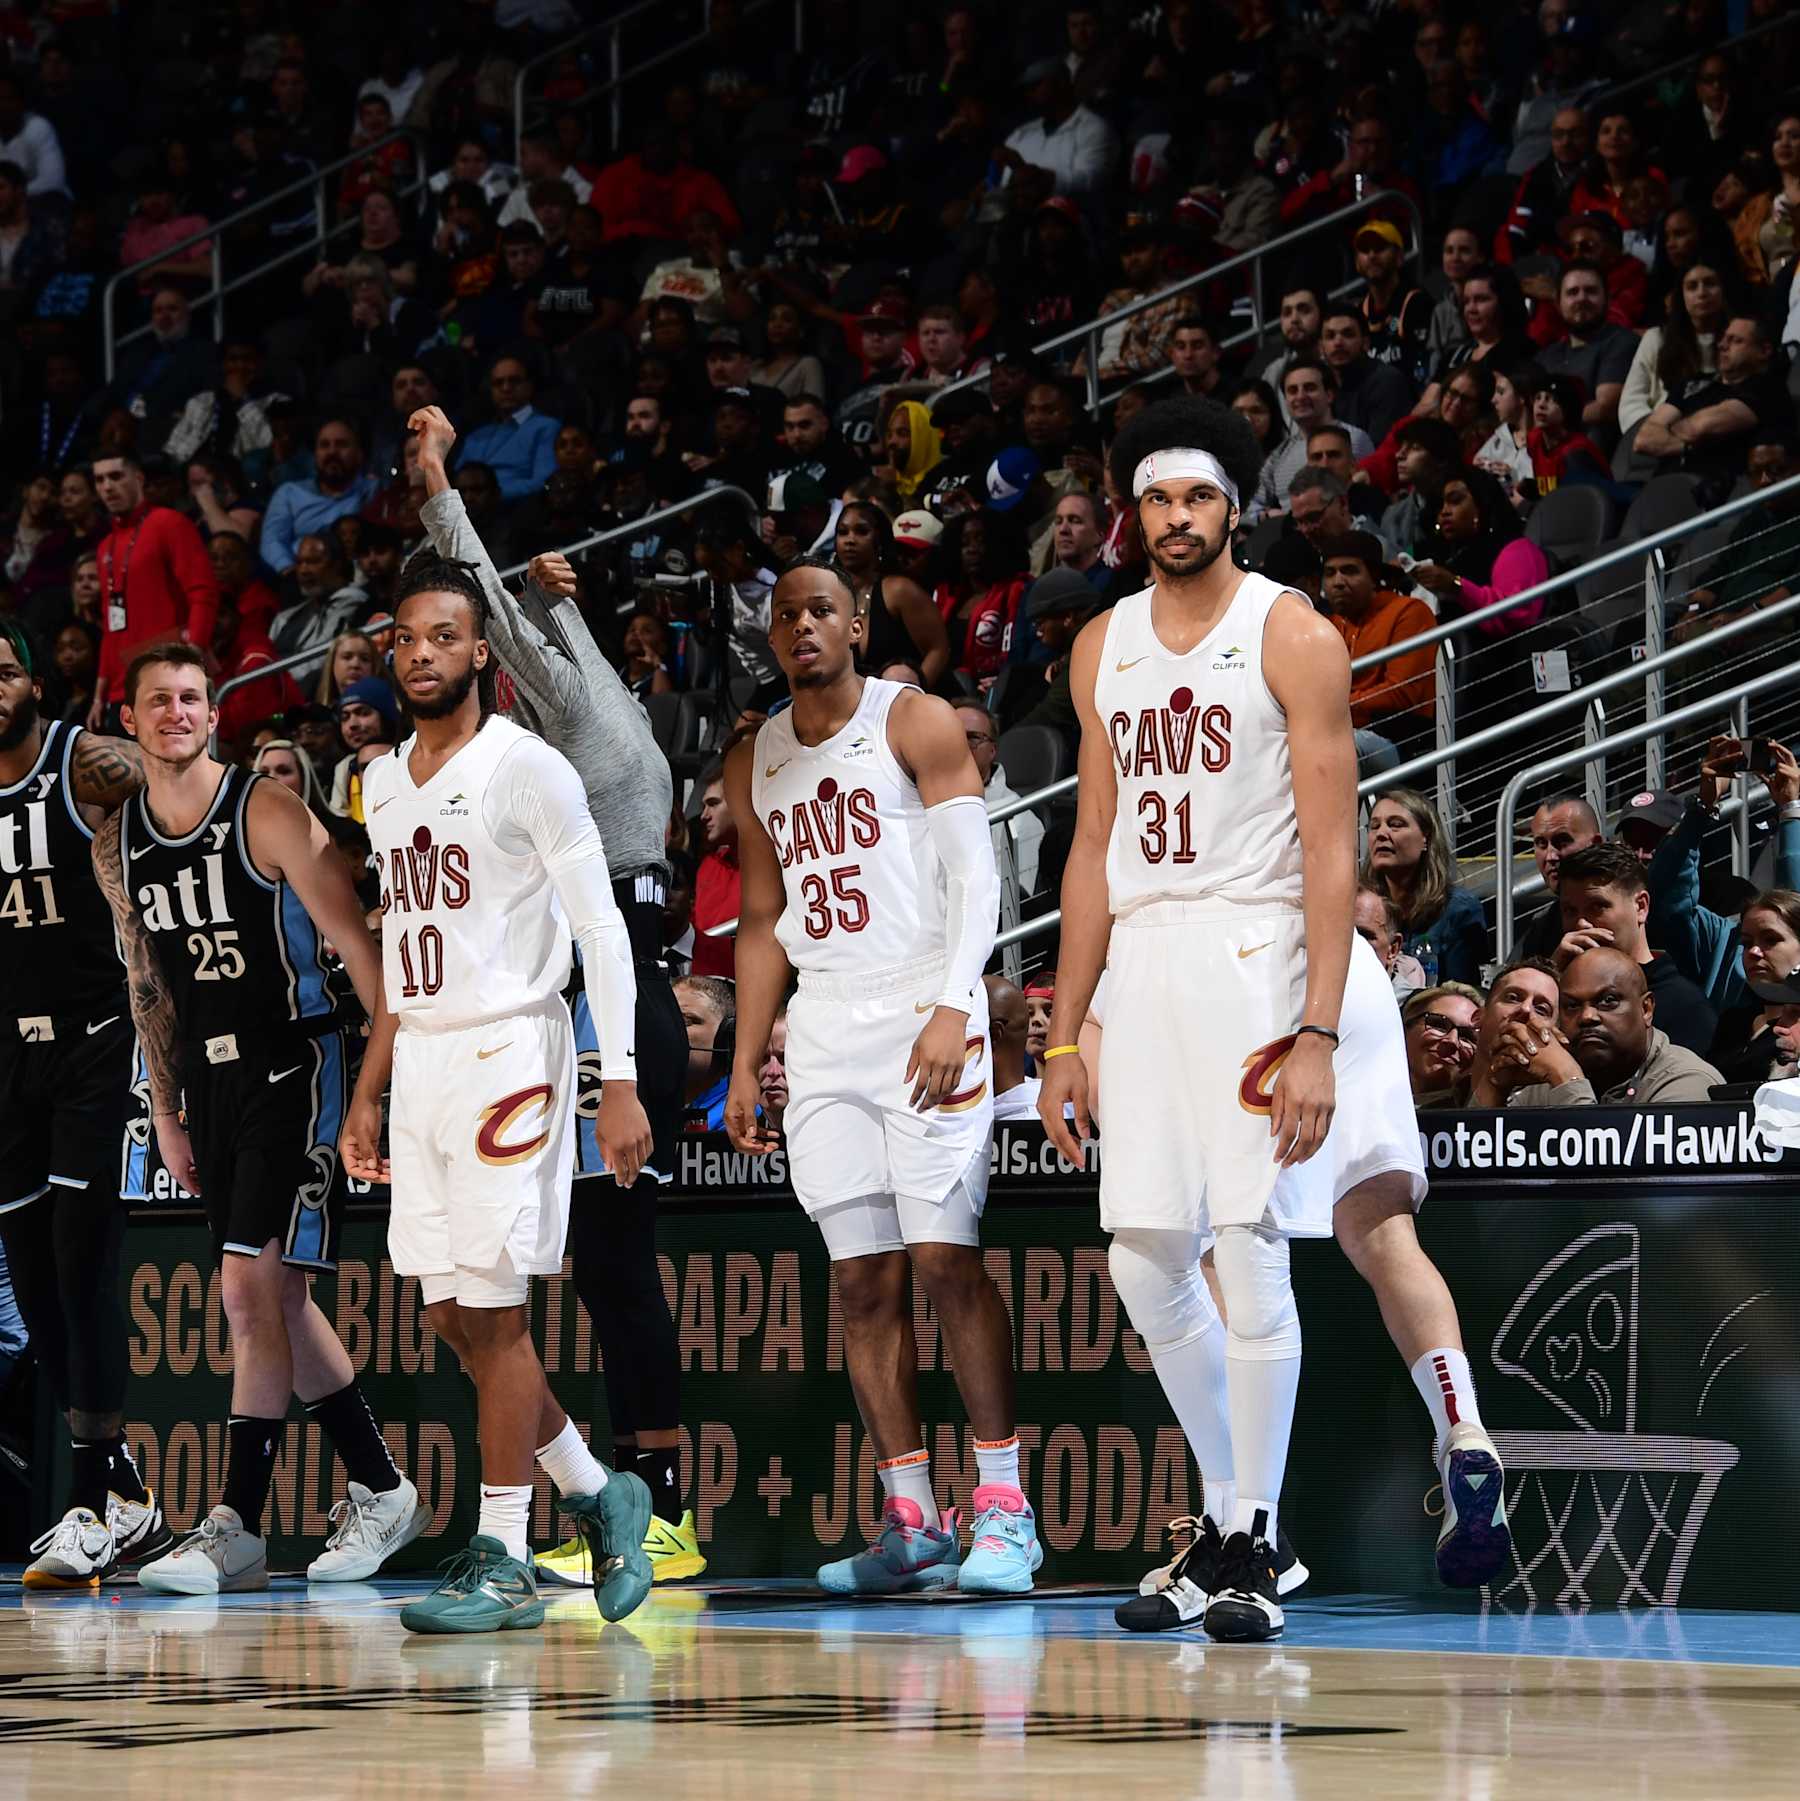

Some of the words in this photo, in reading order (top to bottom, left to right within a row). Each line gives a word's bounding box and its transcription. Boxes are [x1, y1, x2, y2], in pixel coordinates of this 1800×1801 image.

[1212, 662, 1245, 670] CLIFFS
[843, 749, 873, 759] CLIFFS
[1110, 704, 1231, 777] CAVS
[440, 808, 469, 816] CLIFFS
[768, 787, 881, 868] CAVS
[1138, 790, 1197, 864] 31
[0, 875, 66, 929] 41
[138, 853, 235, 932] atl
[801, 864, 870, 940] 35
[187, 930, 247, 981] 25
[399, 925, 443, 997] 10
